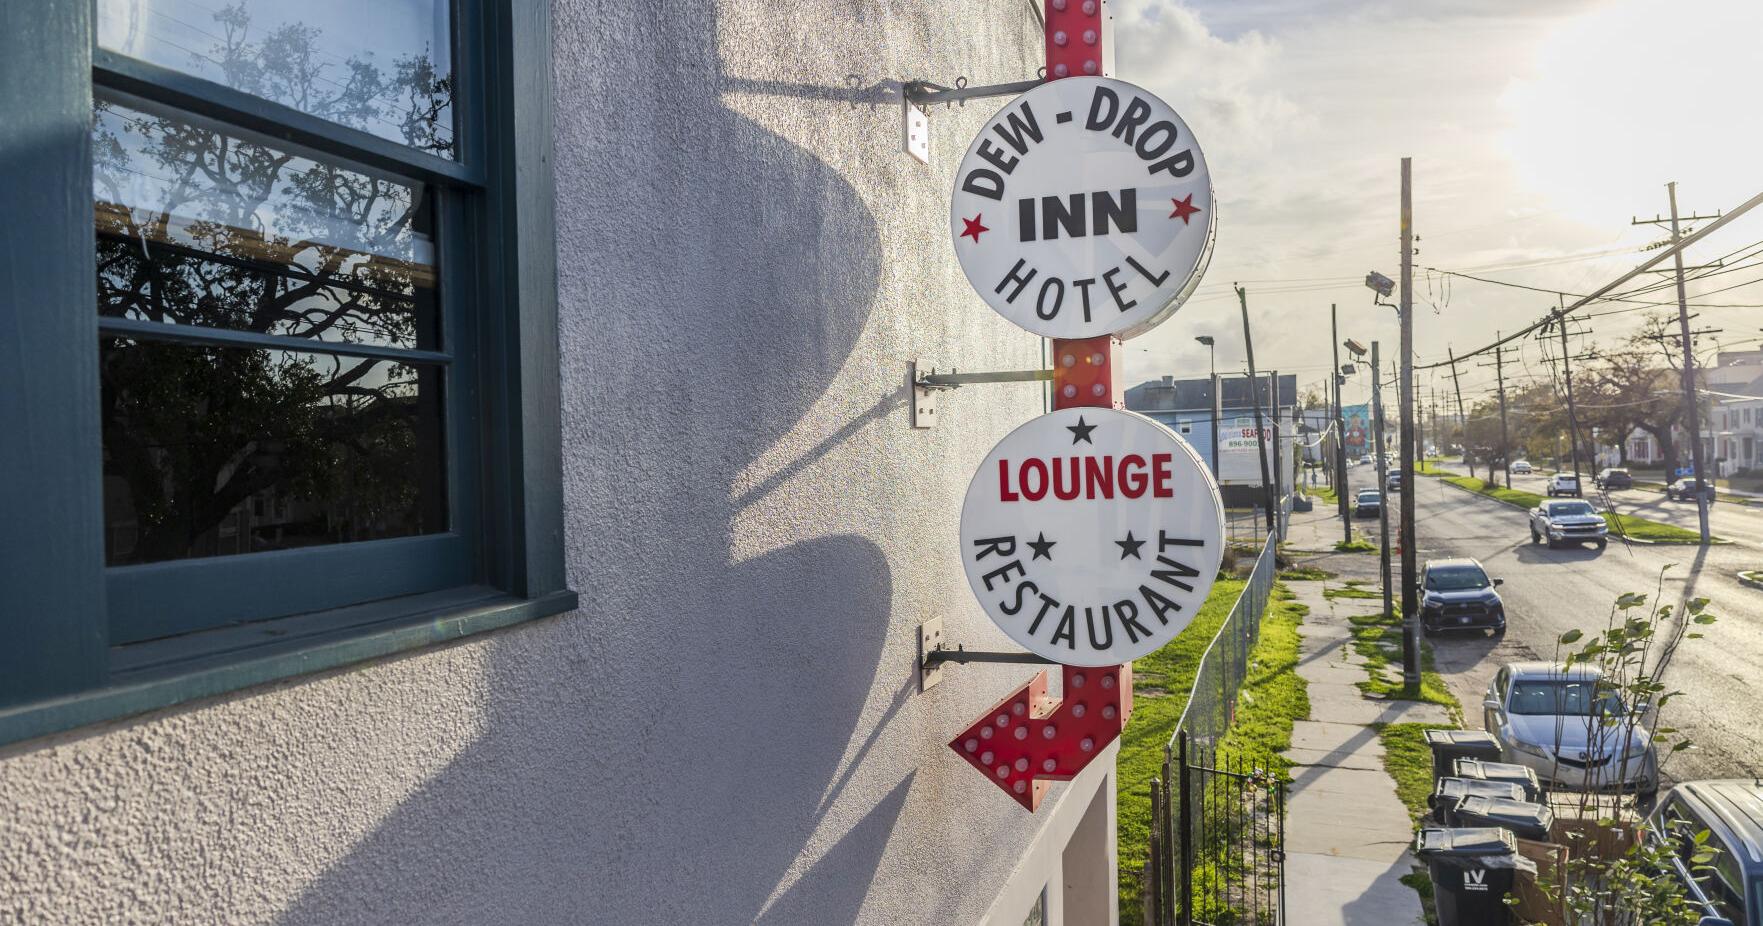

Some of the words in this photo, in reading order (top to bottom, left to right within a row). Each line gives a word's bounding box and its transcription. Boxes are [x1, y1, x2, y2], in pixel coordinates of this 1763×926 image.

[962, 100, 1044, 201] DEW
[1085, 85, 1195, 178] DROP
[1018, 188, 1138, 242] INN
[994, 255, 1170, 323] HOTEL
[1228, 440, 1259, 448] 896-900
[1241, 428, 1271, 441] SEAFD
[998, 453, 1174, 502] LOUNGE
[974, 530, 1205, 650] RESTAURANT
